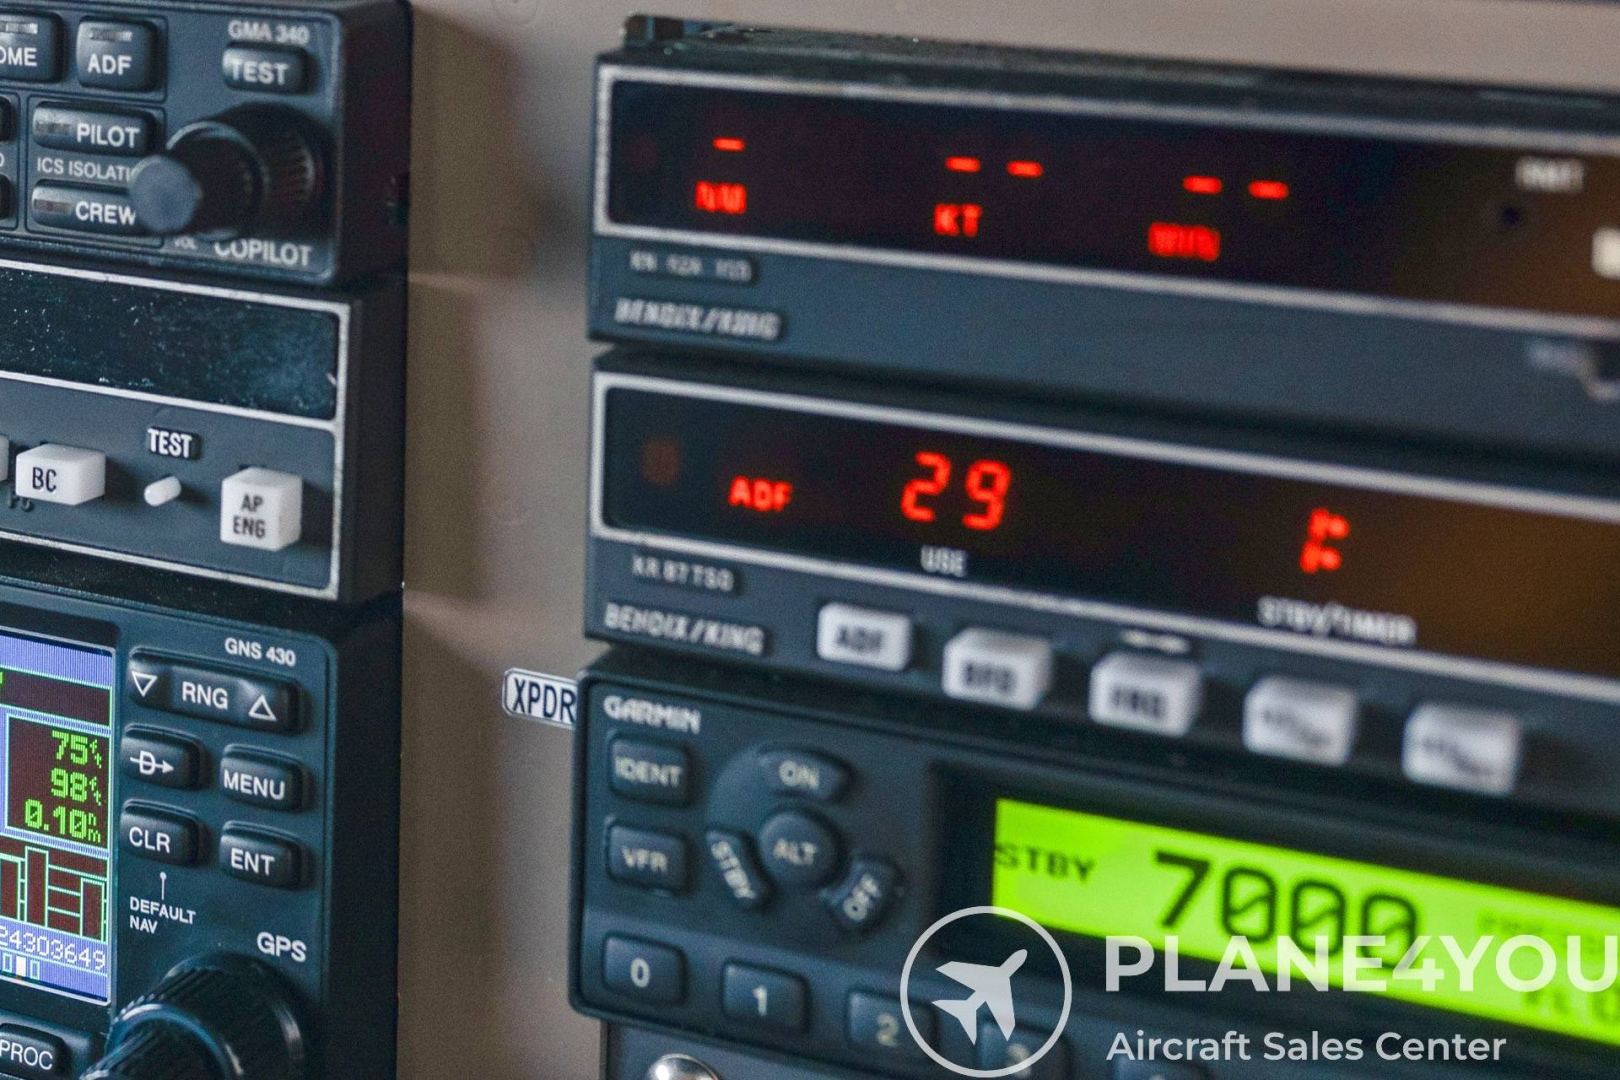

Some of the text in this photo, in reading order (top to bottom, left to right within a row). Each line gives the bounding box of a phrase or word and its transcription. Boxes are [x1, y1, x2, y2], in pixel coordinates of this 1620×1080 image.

[227, 20, 310, 45] GMA 340
[86, 54, 132, 76] ADF
[230, 56, 290, 85] TEST
[76, 123, 140, 149] PILOT
[37, 156, 64, 175] ICS
[75, 201, 137, 226] CREW
[146, 425, 194, 459] TEST
[31, 465, 58, 492] BC
[727, 474, 794, 513] ADF
[900, 450, 1013, 532] 29
[240, 493, 264, 514] AP
[232, 515, 267, 539] ENG
[224, 637, 297, 667] GNS 430
[181, 680, 229, 711] RNG
[511, 677, 578, 722] XPDR
[603, 695, 702, 734] GARMIN
[223, 768, 286, 801] MENU
[614, 756, 683, 787] IDENT
[779, 759, 820, 791] ON
[128, 826, 171, 854] CLR
[230, 847, 275, 877] ENT
[621, 846, 669, 872] VFR
[129, 896, 197, 926] DEFAULT
[996, 841, 1098, 883] STBY
[1151, 849, 1424, 972] 7000
[129, 914, 158, 934] NAV
[256, 930, 308, 964] GPS
[629, 956, 651, 989] 0
[751, 985, 769, 1018] 1
